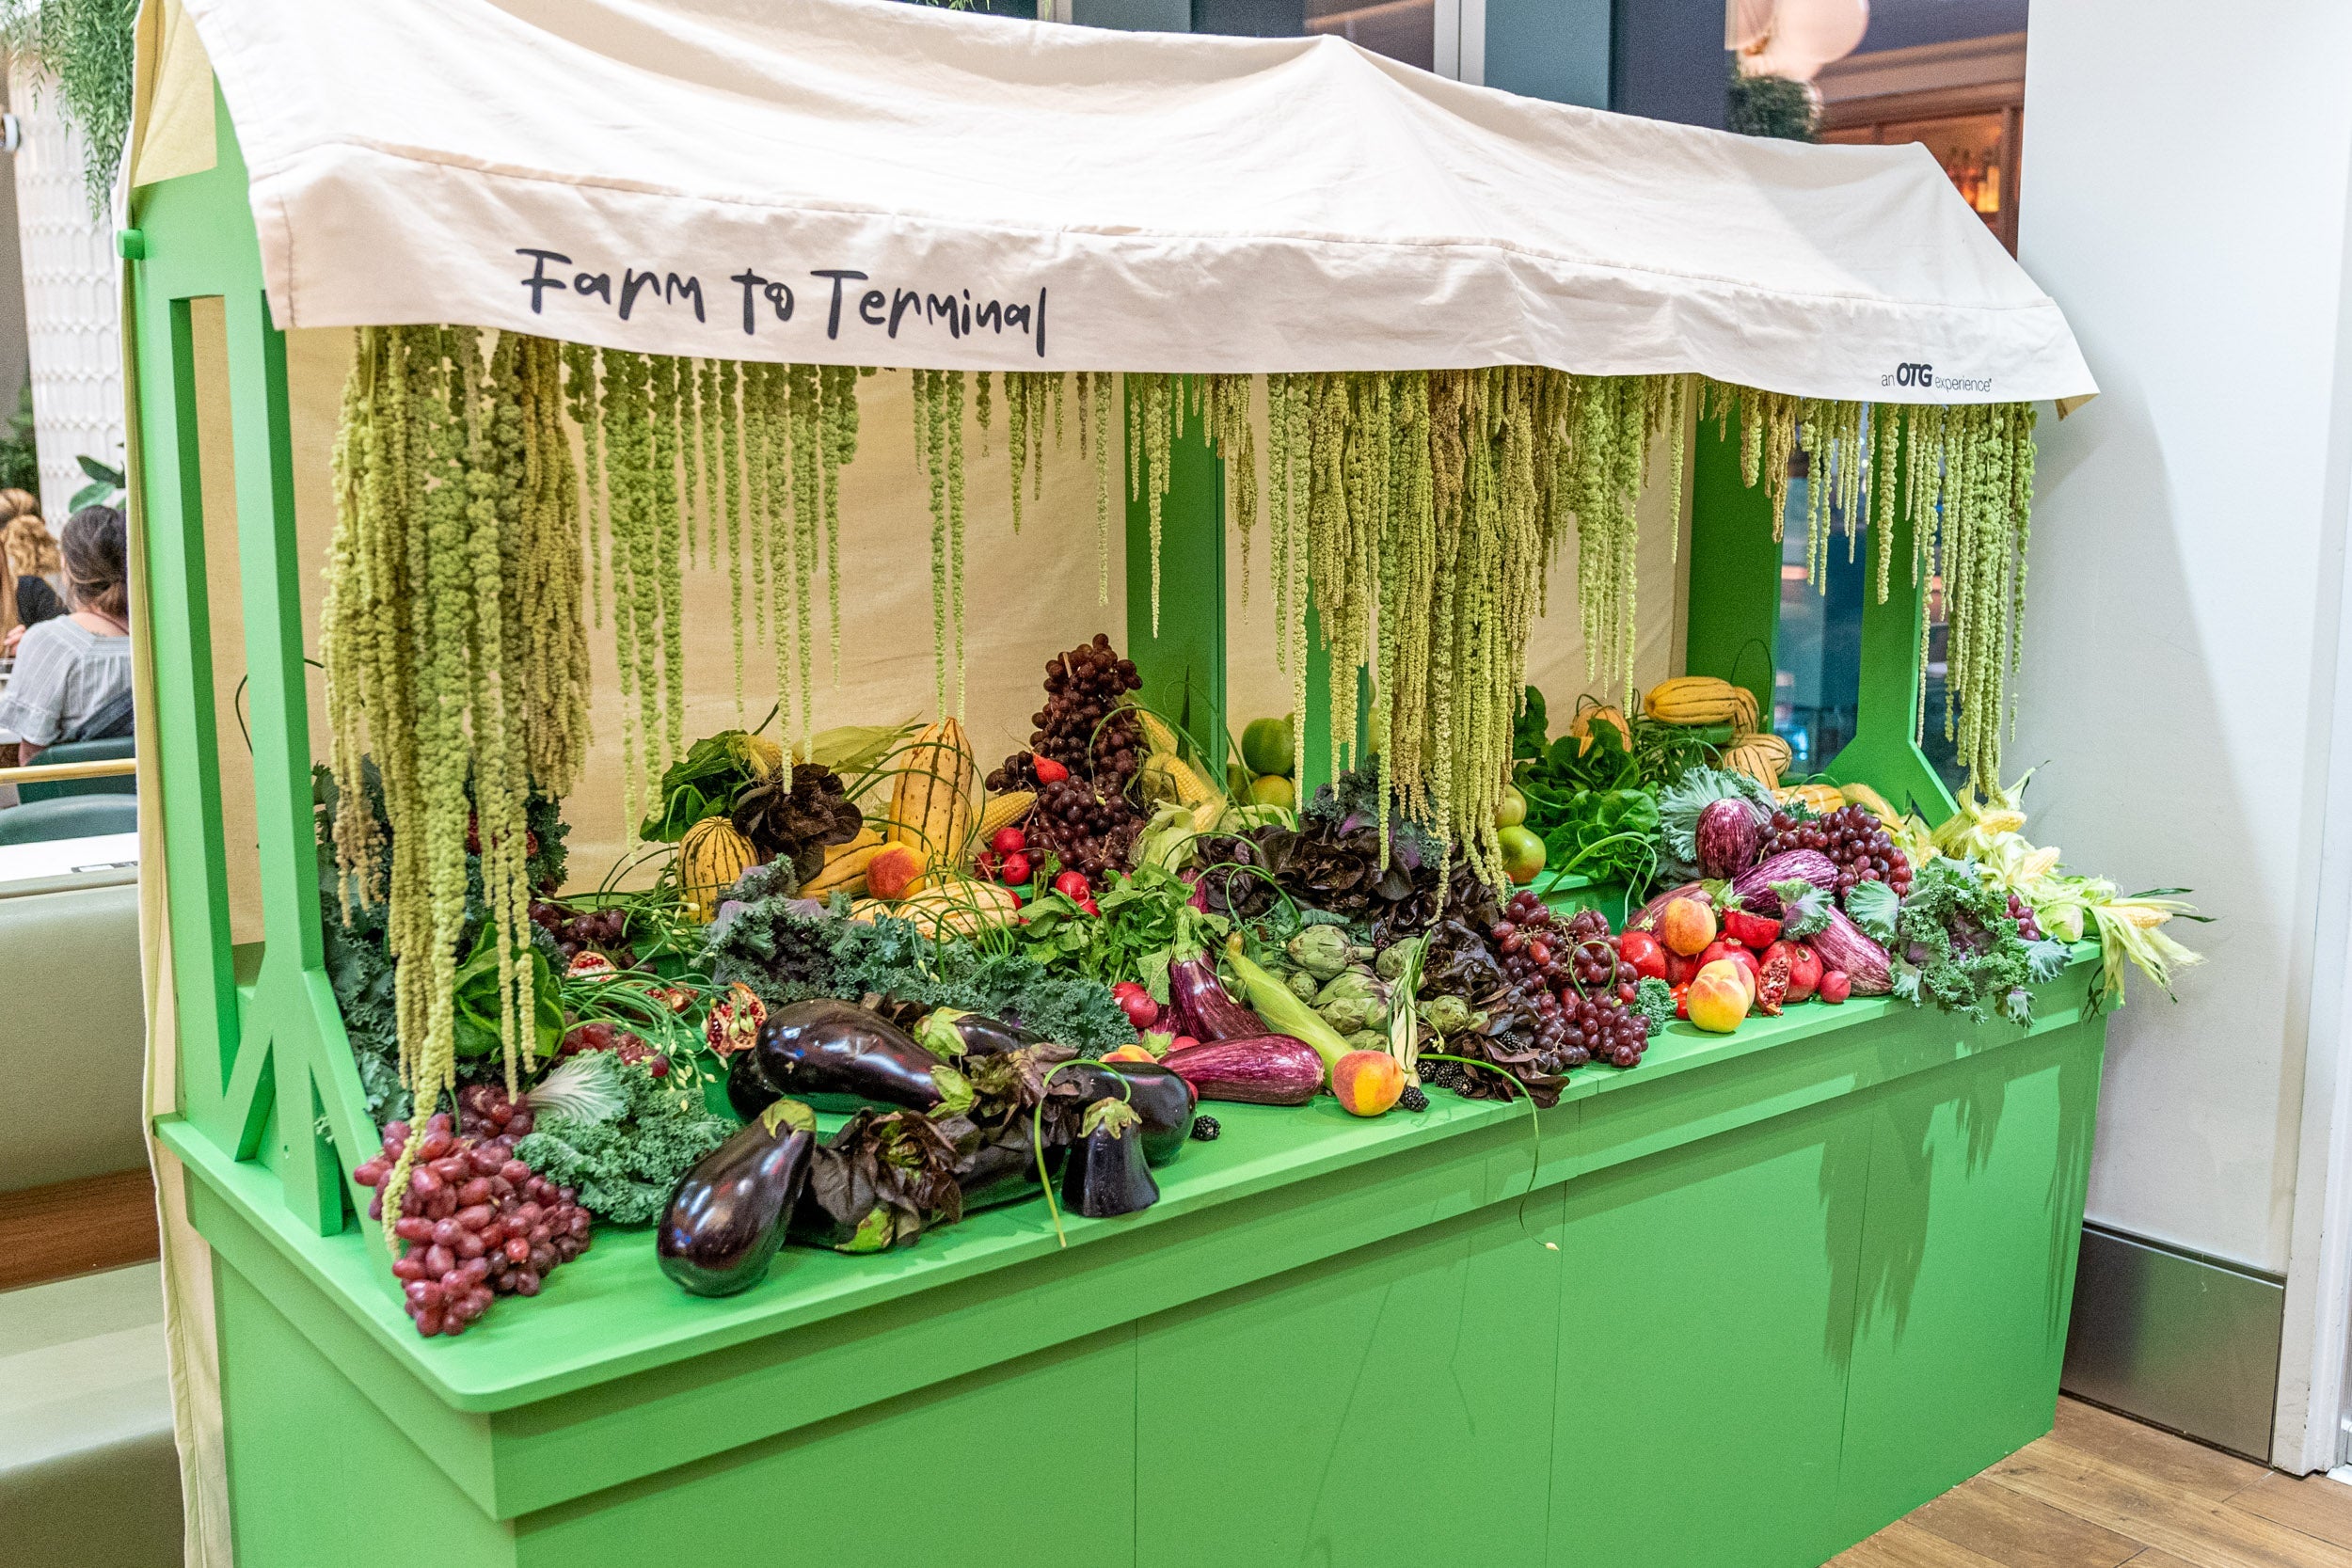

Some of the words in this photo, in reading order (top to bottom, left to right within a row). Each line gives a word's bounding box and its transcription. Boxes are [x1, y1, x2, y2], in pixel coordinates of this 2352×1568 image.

[516, 248, 706, 324] Farm
[730, 267, 794, 335] to
[810, 270, 1047, 358] Terminal
[1882, 373, 1895, 387] an
[1897, 362, 1933, 388] OTG
